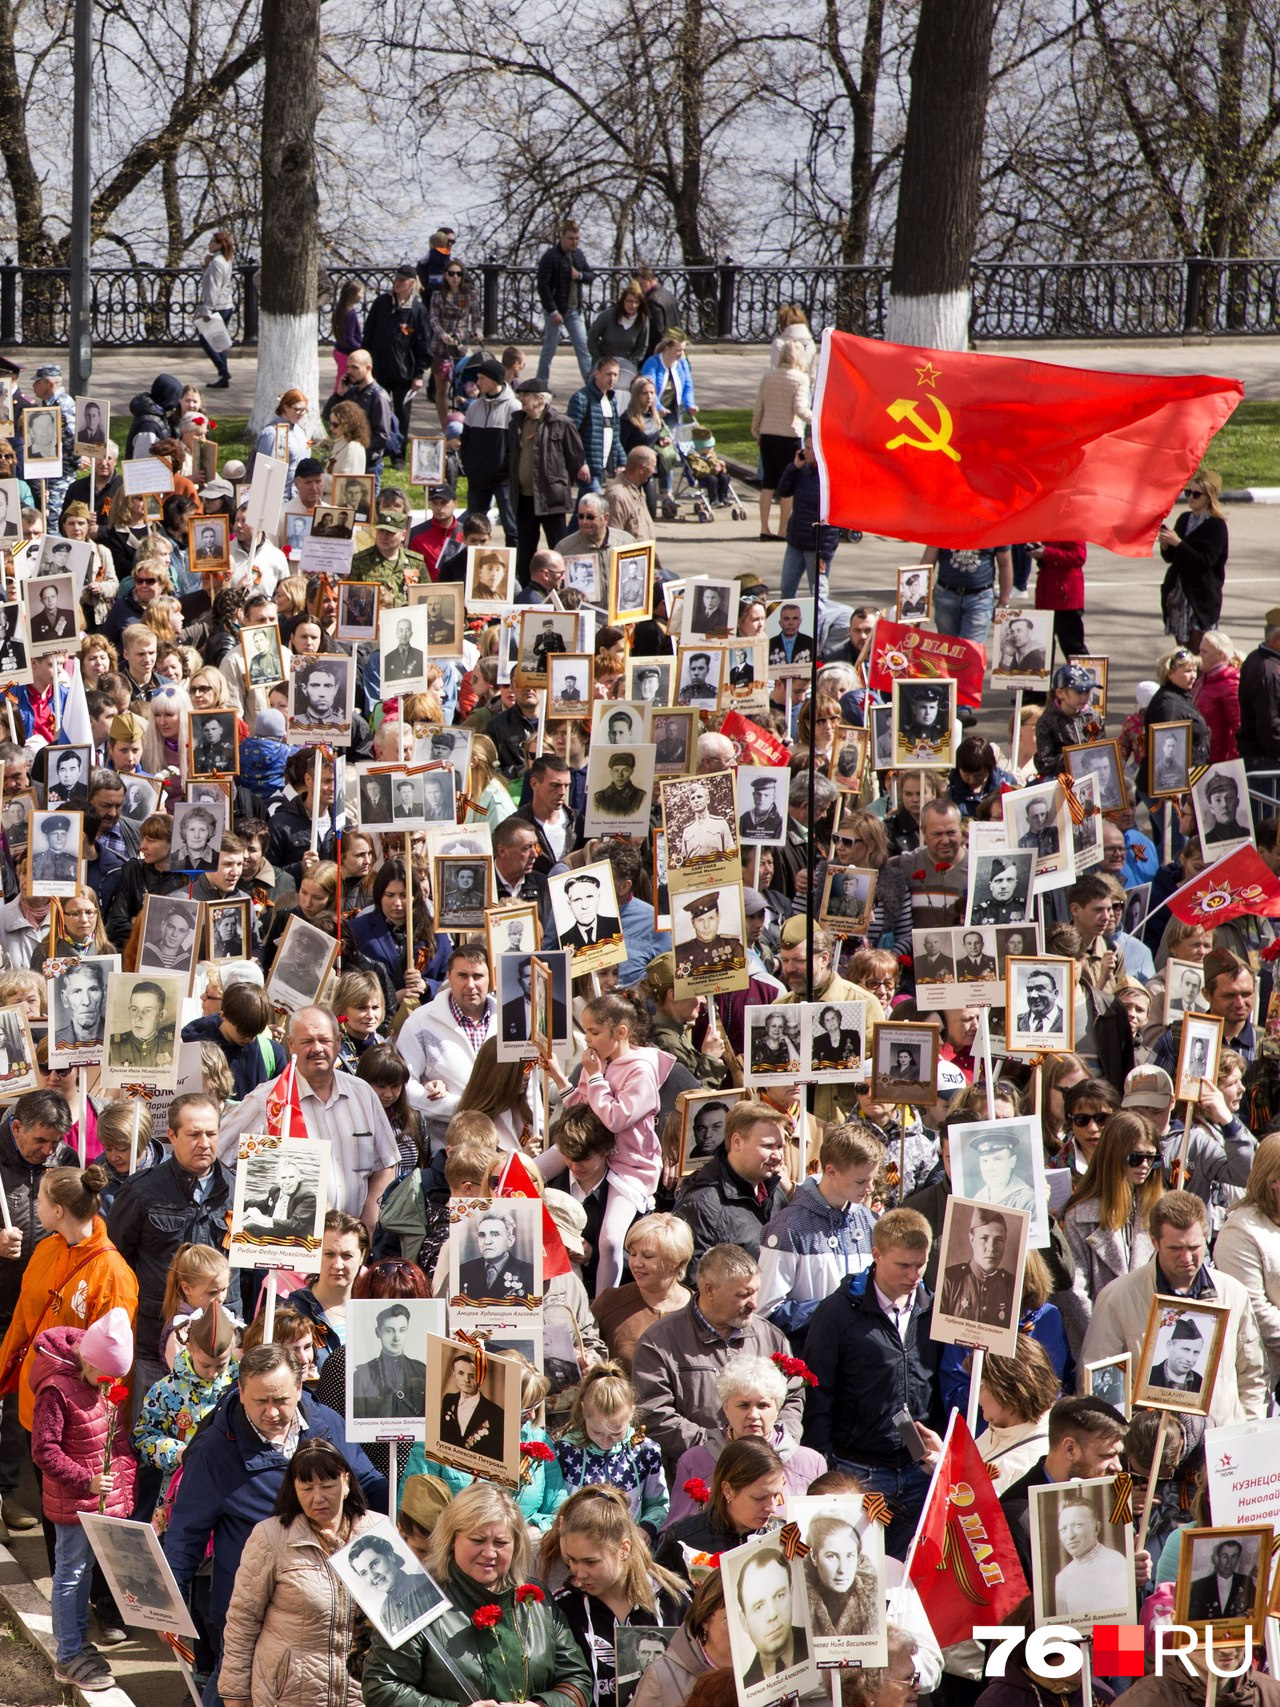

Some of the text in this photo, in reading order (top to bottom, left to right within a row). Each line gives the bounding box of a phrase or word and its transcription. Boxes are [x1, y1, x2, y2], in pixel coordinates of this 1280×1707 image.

[903, 632, 967, 659] 9 МАЯ
[745, 731, 781, 763] 9 МАЯ
[965, 1320, 977, 1329] Иван
[436, 1441, 452, 1451] Гусев
[452, 1445, 477, 1461] Алексей
[477, 1455, 508, 1471] Петрович
[1238, 1489, 1280, 1508] Николай
[948, 1481, 1006, 1588] 9 МАЯ
[846, 1639, 879, 1648] Васильевна
[783, 1665, 810, 1681] Алексеевич
